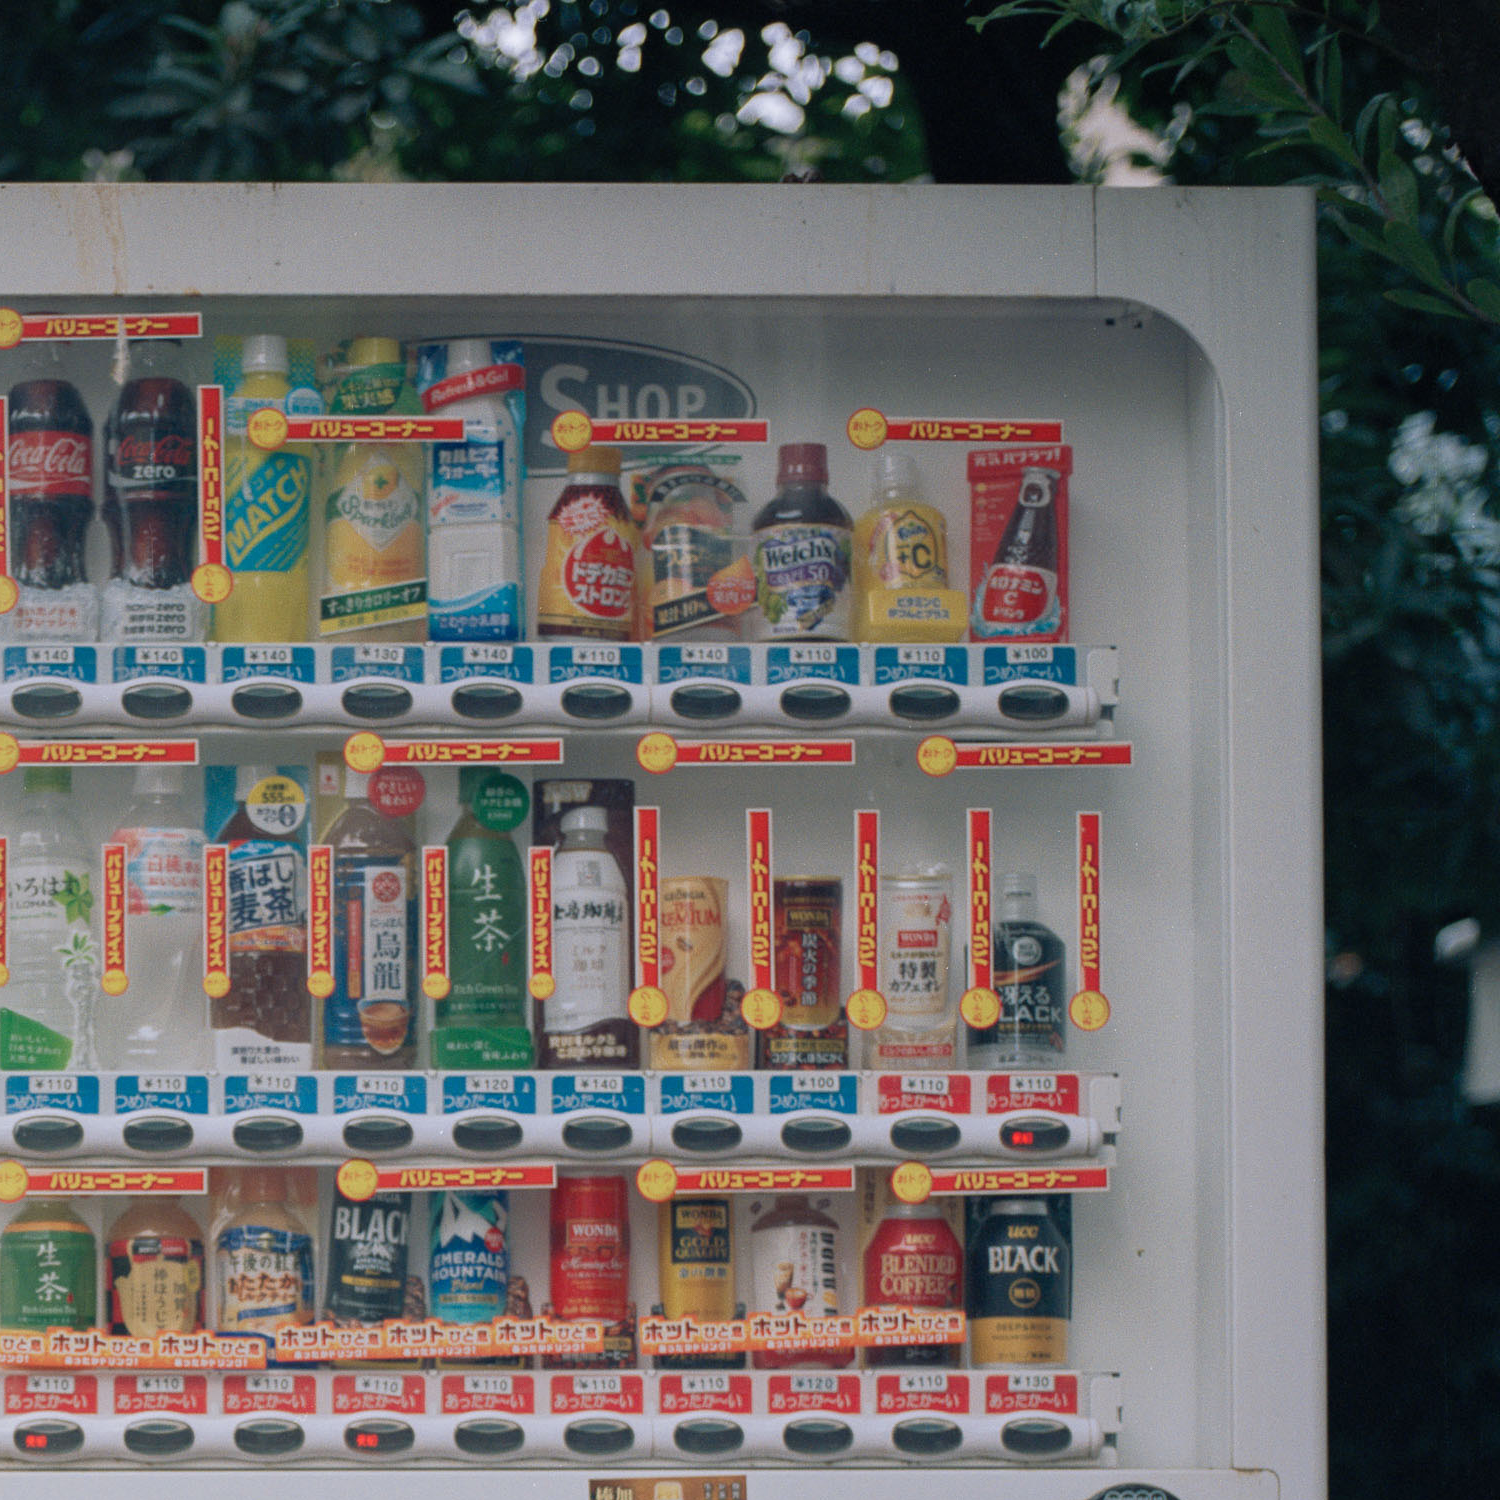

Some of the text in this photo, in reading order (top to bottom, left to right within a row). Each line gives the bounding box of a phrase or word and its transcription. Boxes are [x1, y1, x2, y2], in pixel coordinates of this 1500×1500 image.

[45, 318, 169, 335] バリューコーナー
[310, 421, 434, 437] バリューコーナー
[614, 423, 738, 440] バリューコーナー
[909, 423, 1032, 440] バリューコーナー
[133, 464, 176, 479] zero
[226, 455, 308, 549] MATCH
[765, 541, 834, 566] Welch's
[807, 565, 830, 583] 50
[1003, 591, 1018, 605] C
[31, 651, 68, 661] ¥140
[141, 651, 178, 661] ¥140
[250, 651, 286, 661] ¥140
[362, 649, 398, 661] ¥130
[470, 650, 507, 660] ¥140
[579, 651, 615, 662] ¥110
[686, 650, 722, 660] ¥140
[795, 650, 831, 660] ¥110
[904, 651, 940, 661] ¥110
[1013, 649, 1047, 659] ¥100
[42, 745, 166, 761] バリューコーナー
[406, 744, 531, 760] バリューコーナー
[700, 744, 823, 760] バリューコーナー
[979, 747, 1102, 764] バリューコーナー
[107, 855, 122, 965] バリュープライス
[209, 857, 224, 967] バリュープライス
[230, 886, 292, 925] 麦茶
[314, 857, 329, 967] バリュープライス
[471, 864, 510, 951] 生茶
[899, 961, 937, 980] 特製
[1000, 1006, 1062, 1023] LACK
[36, 1079, 72, 1090] ¥110
[145, 1079, 181, 1090] ¥110
[254, 1075, 291, 1089] ¥110
[363, 1080, 398, 1092] ¥110
[472, 1079, 508, 1090] ¥120
[689, 1077, 725, 1088] ¥110
[799, 1077, 834, 1088] ¥100
[908, 1079, 944, 1091] ¥110
[1015, 1079, 1051, 1090] ¥110
[50, 1173, 174, 1189] バリューコーナー
[400, 1169, 524, 1186] バリューコーナー
[700, 1171, 823, 1188] バリューコーナー
[954, 1172, 1077, 1190] バリューコーナー
[679, 1236, 725, 1248] GOLD
[880, 1253, 956, 1275] BLENDED
[988, 1245, 1061, 1274] BLACK
[36, 1241, 69, 1301] 生茶
[31, 1379, 69, 1390] ¥110
[796, 1377, 833, 1389] ¥120
[1013, 1376, 1049, 1387] ¥130
